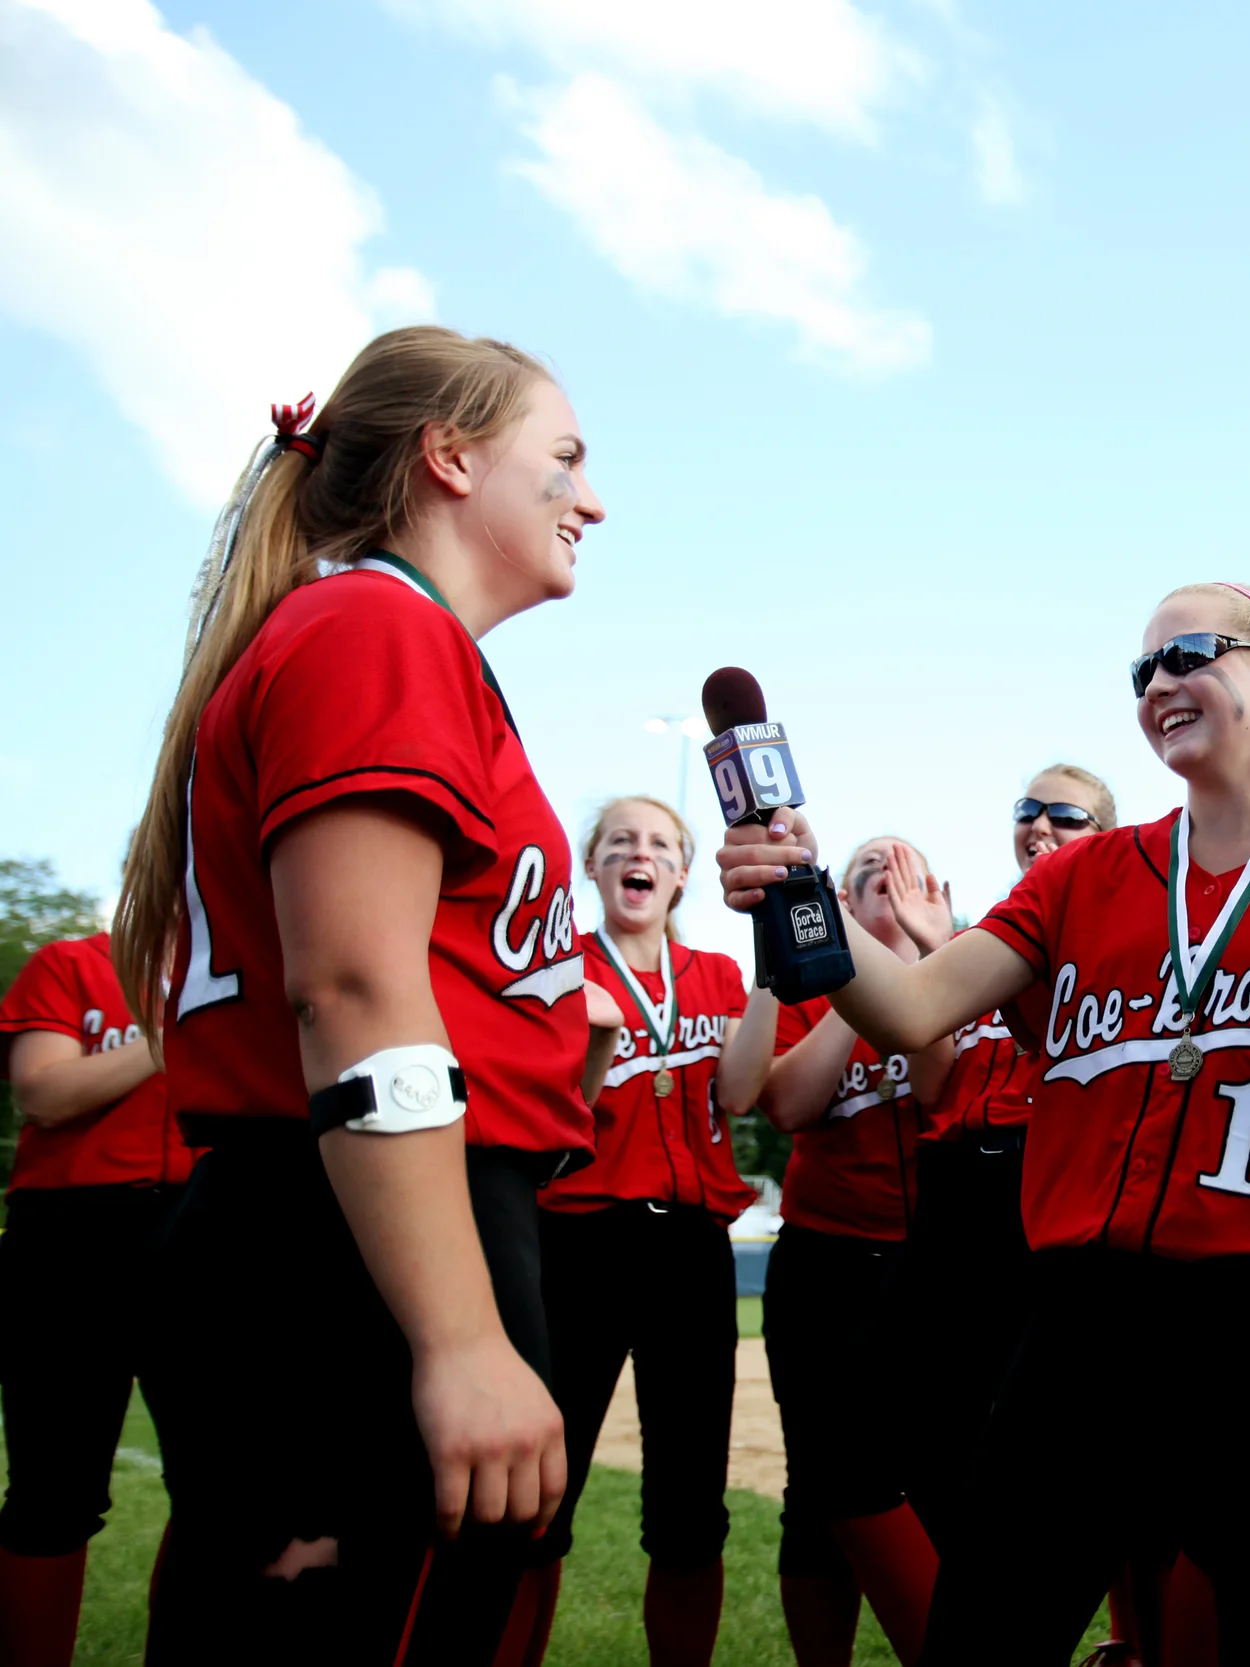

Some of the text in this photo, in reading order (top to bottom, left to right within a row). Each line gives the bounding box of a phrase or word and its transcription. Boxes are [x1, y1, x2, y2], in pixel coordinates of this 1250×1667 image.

[736, 725, 780, 742] WMUR
[749, 747, 792, 805] 9
[714, 759, 747, 820] 9
[796, 909, 822, 926] porta
[799, 926, 824, 940] brace
